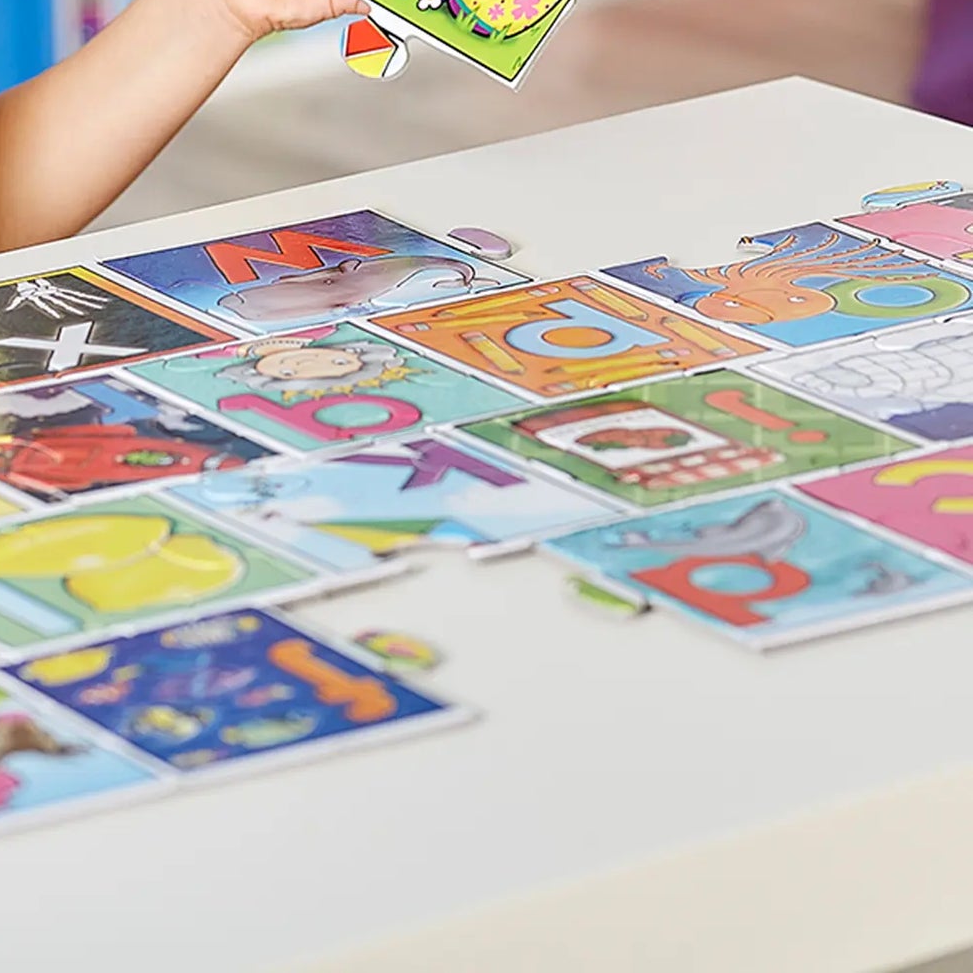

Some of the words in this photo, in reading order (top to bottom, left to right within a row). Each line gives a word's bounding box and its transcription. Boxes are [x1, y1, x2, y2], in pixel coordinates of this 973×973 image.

[203, 228, 394, 285] w
[824, 273, 971, 319] o
[334, 438, 529, 491] k
